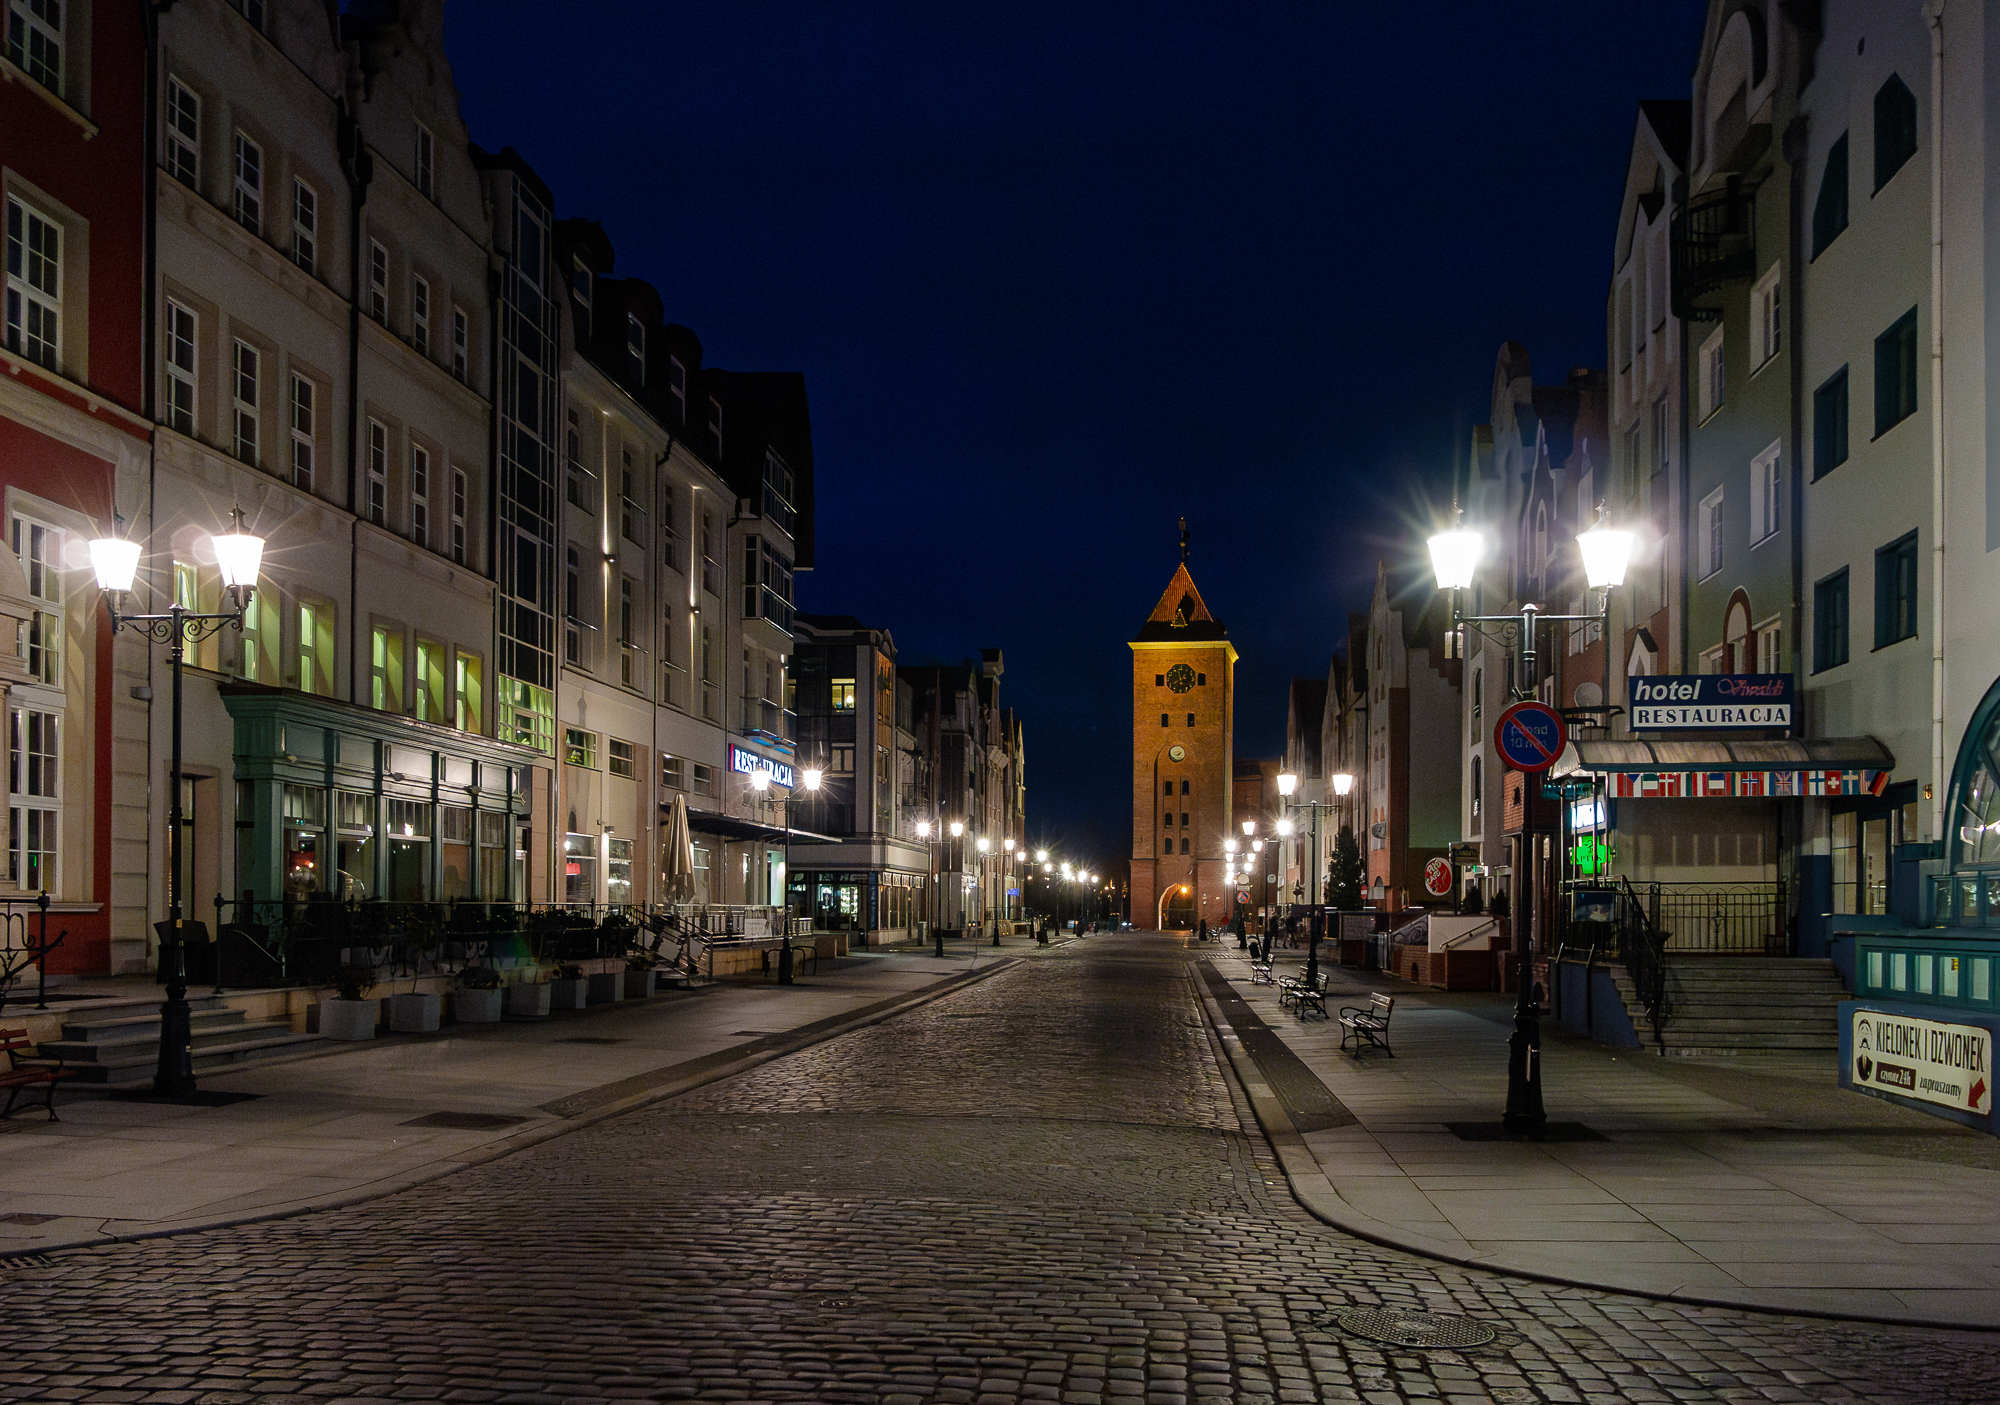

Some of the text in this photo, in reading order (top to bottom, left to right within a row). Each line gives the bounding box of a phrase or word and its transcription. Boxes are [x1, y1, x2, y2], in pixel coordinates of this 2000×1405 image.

[1634, 679, 1702, 701] hotel
[1637, 707, 1787, 724] RESTAURACJA
[1510, 737, 1522, 748] 10
[734, 748, 794, 788] RESTURACJA
[1876, 1020, 1985, 1073] KIELONEK I DZWONEK
[1899, 1069, 1911, 1086] 24h
[1919, 1076, 1962, 1101] zapraszamy
